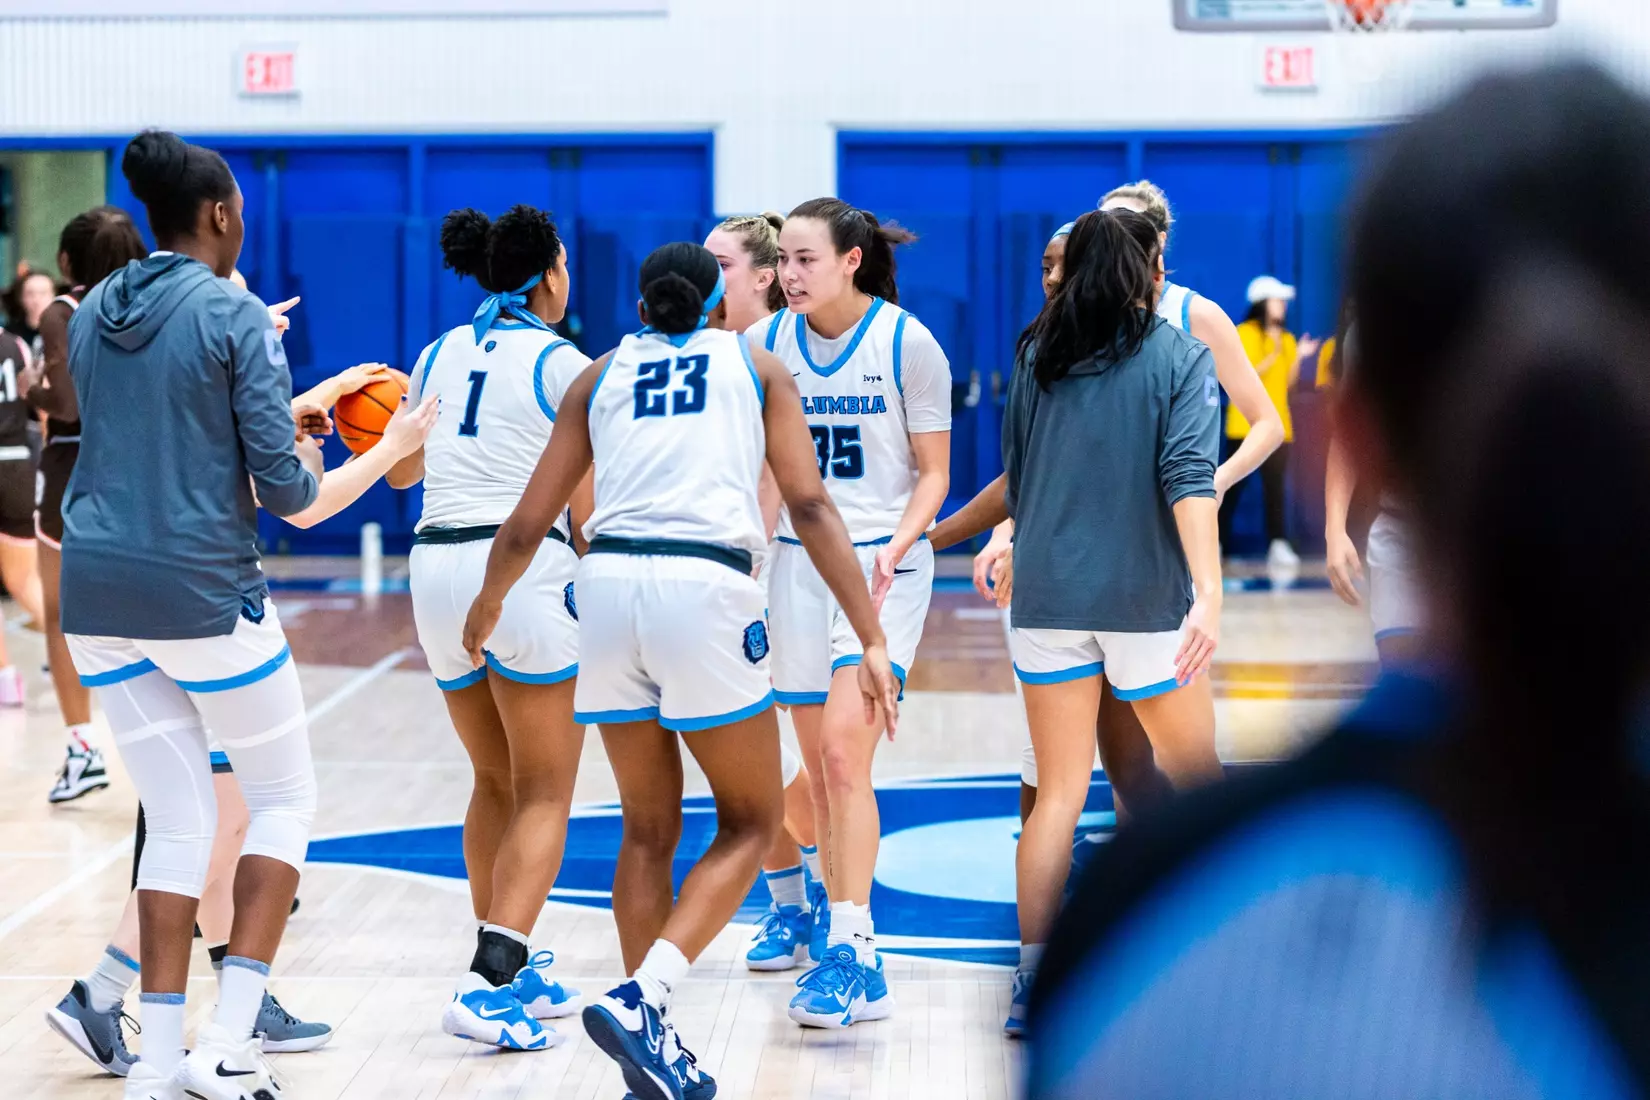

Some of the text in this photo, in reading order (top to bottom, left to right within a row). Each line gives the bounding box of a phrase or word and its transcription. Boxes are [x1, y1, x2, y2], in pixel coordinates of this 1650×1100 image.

[246, 53, 294, 91] EXIT
[1265, 47, 1313, 85] EXIT
[0, 357, 17, 402] 1
[633, 353, 709, 420] 23
[863, 373, 876, 384] Ivy
[457, 369, 488, 438] 1
[800, 395, 887, 415] LUMBIA
